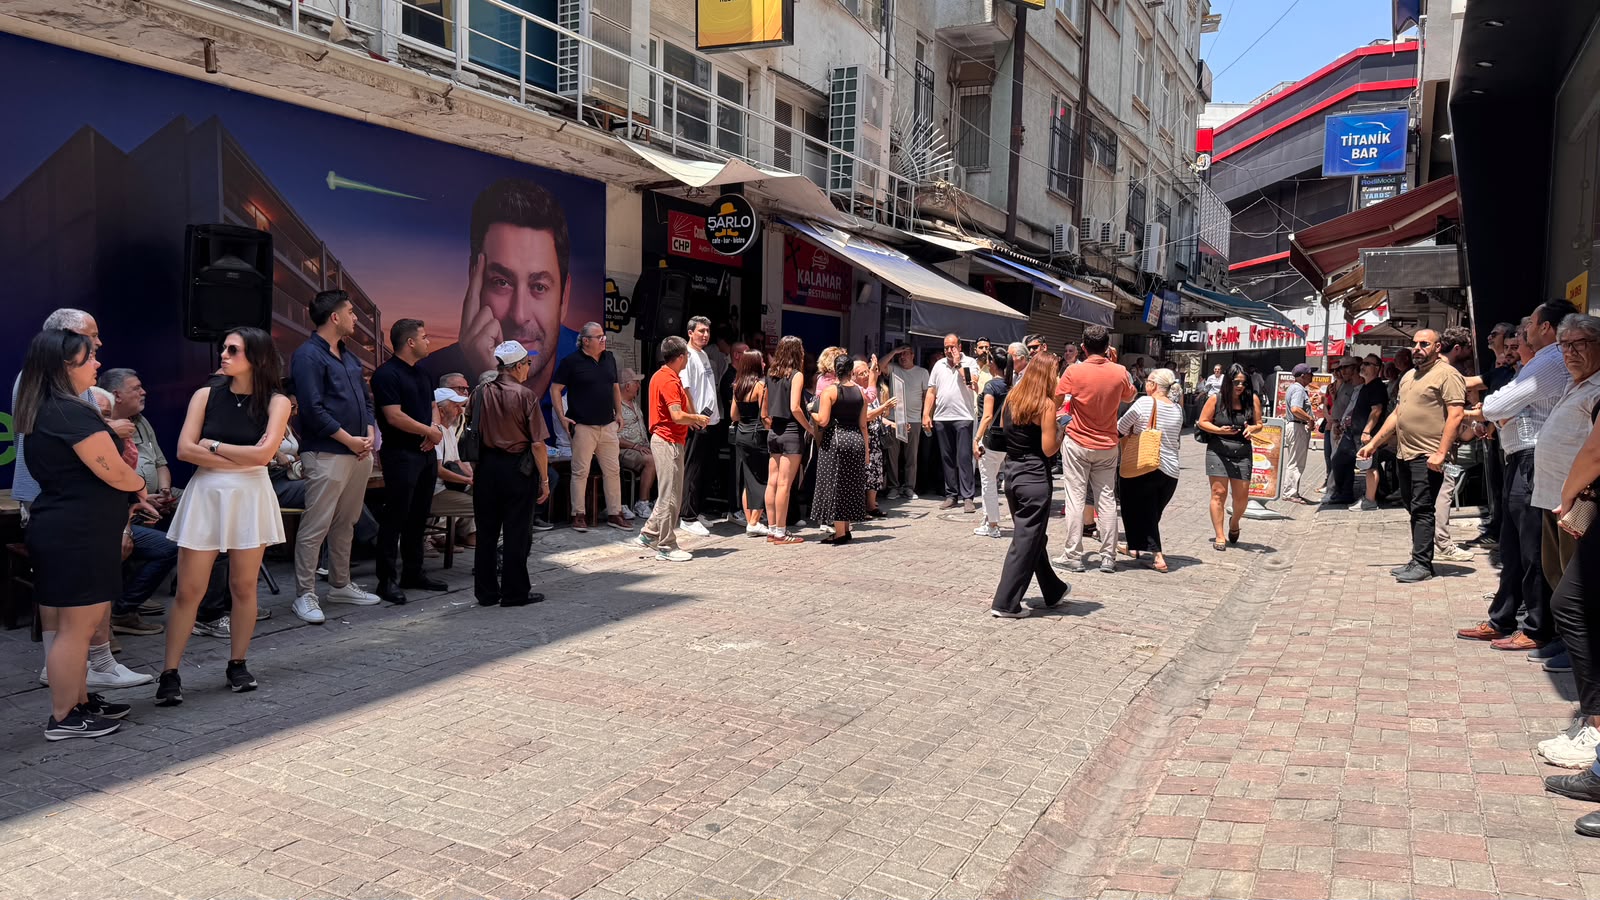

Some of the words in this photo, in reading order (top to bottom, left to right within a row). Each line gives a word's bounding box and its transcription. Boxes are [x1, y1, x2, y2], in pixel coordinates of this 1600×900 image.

[1341, 131, 1391, 146] TİTANİK
[1351, 148, 1378, 160] BAR
[673, 240, 690, 252] CHP
[797, 269, 842, 290] KALAMAR
